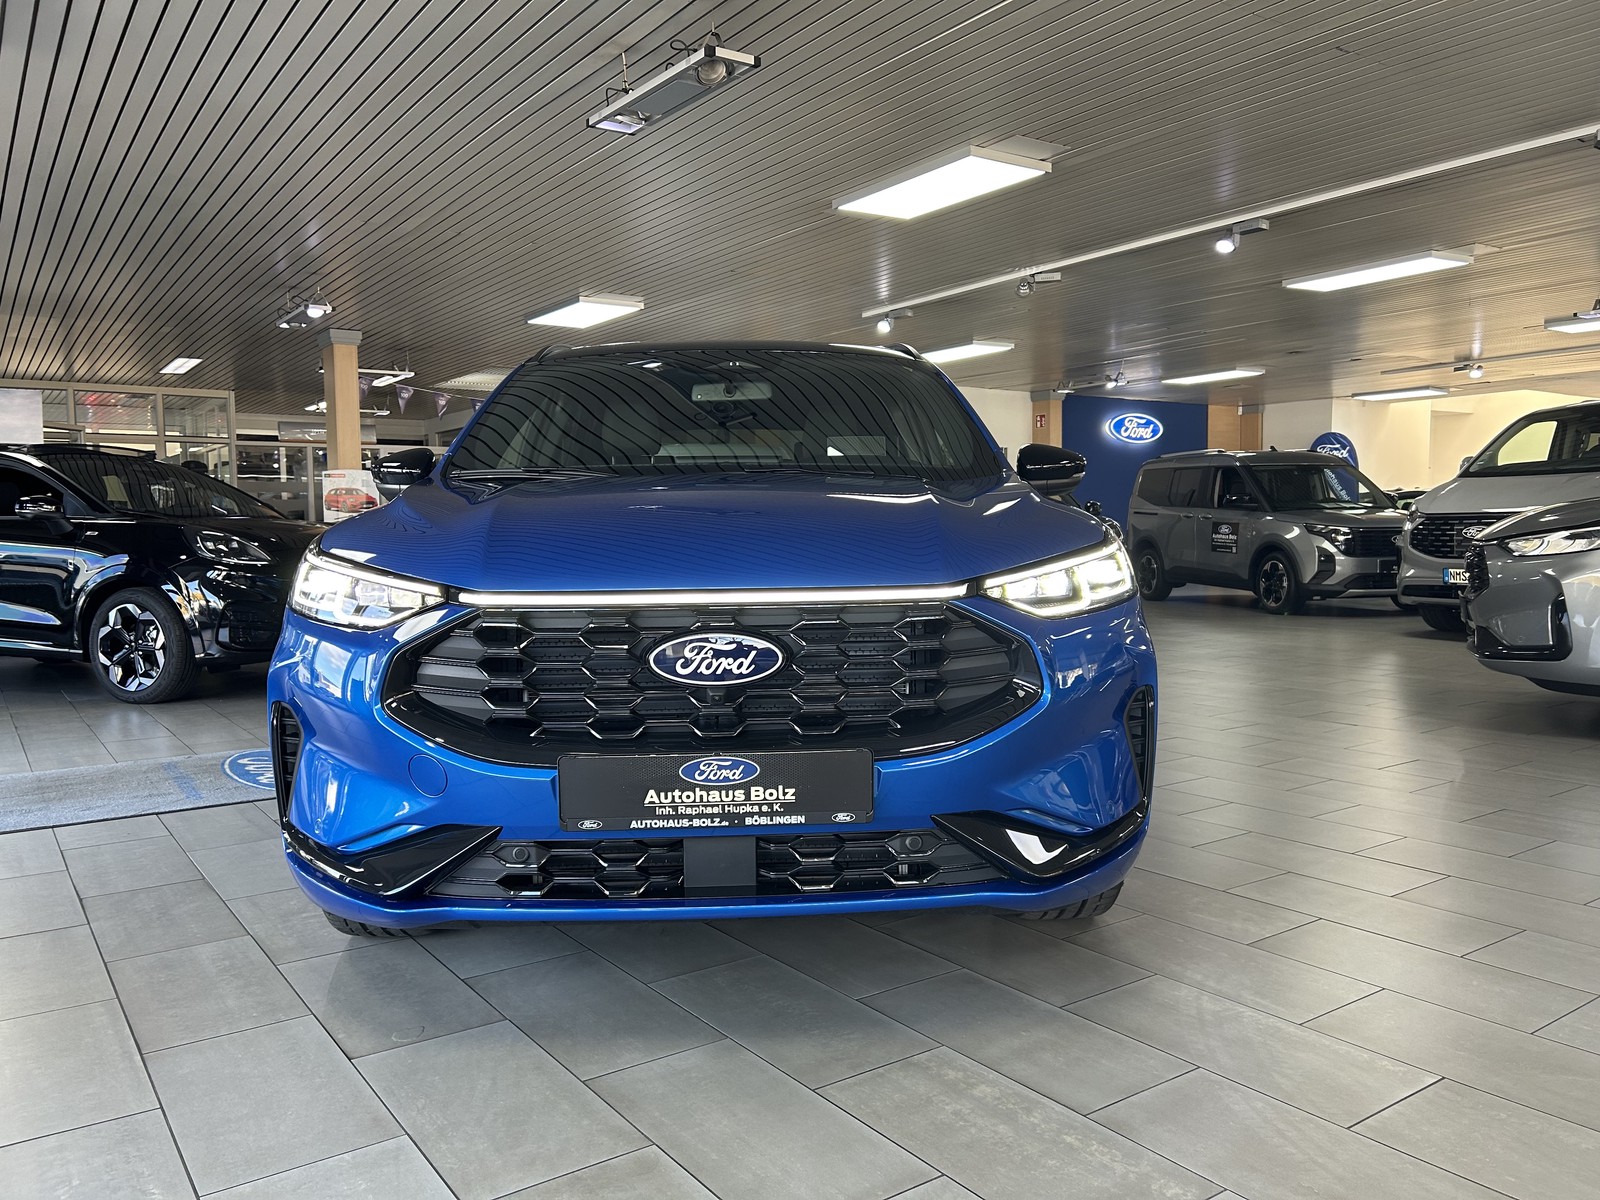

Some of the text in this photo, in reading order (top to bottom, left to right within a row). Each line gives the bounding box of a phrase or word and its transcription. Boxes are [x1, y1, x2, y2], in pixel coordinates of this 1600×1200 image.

[1121, 416, 1154, 438] Ford
[675, 642, 757, 675] Ford
[694, 760, 745, 781] Ford
[643, 785, 796, 804] Autohaus Bolz
[655, 803, 784, 816] Inh. Raphael Hupka e. K.
[745, 815, 806, 825] BÖBLINGEN
